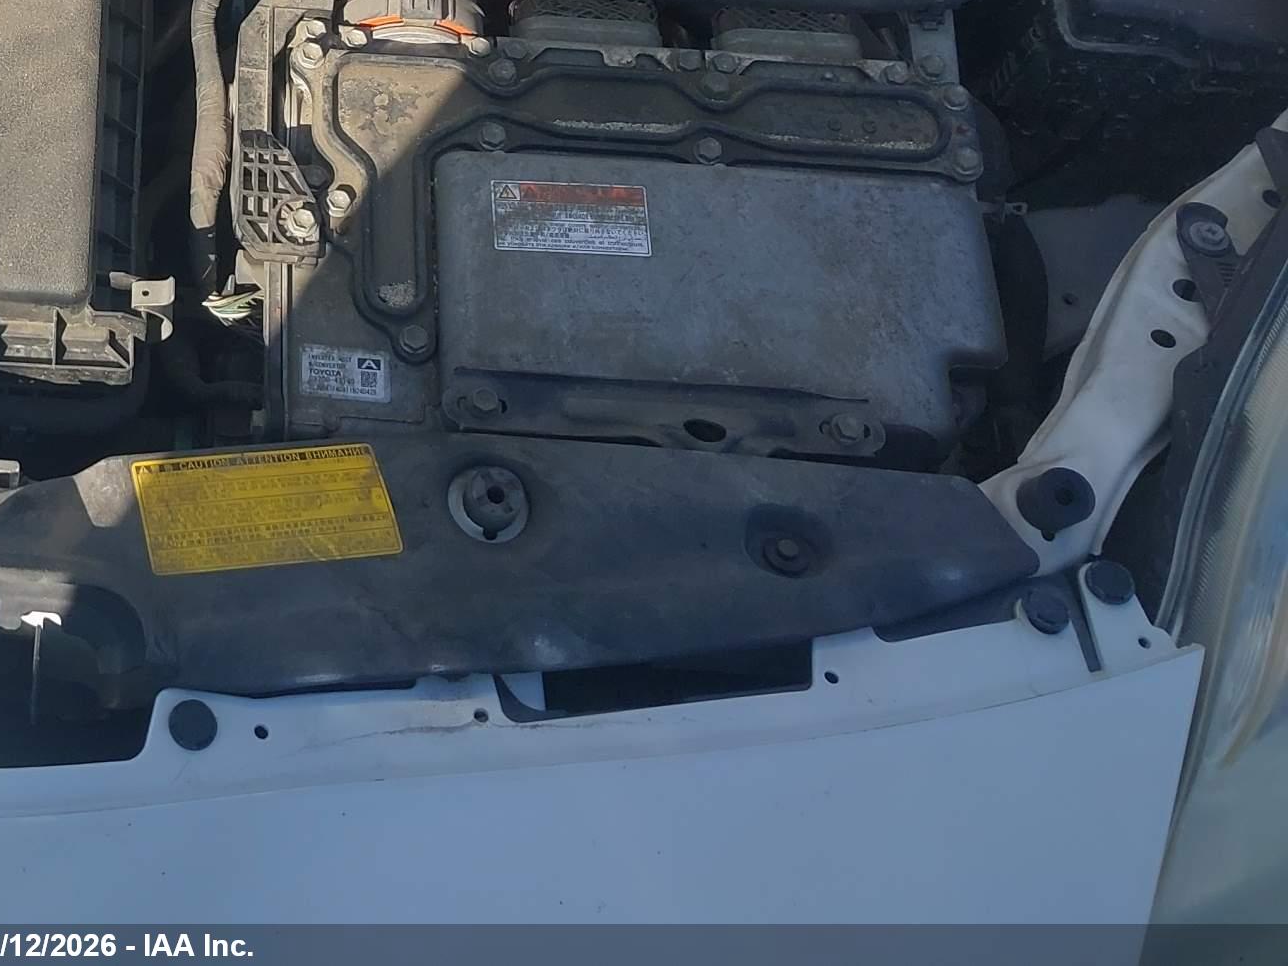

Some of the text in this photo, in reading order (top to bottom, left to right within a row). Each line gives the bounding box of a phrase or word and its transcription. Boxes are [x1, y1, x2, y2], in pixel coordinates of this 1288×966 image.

[309, 368, 342, 378] TOYOTA
[179, 457, 230, 471] CAUTION
[236, 451, 301, 465] ATTENTION
[305, 445, 369, 460] ВНИМАНИЕ
